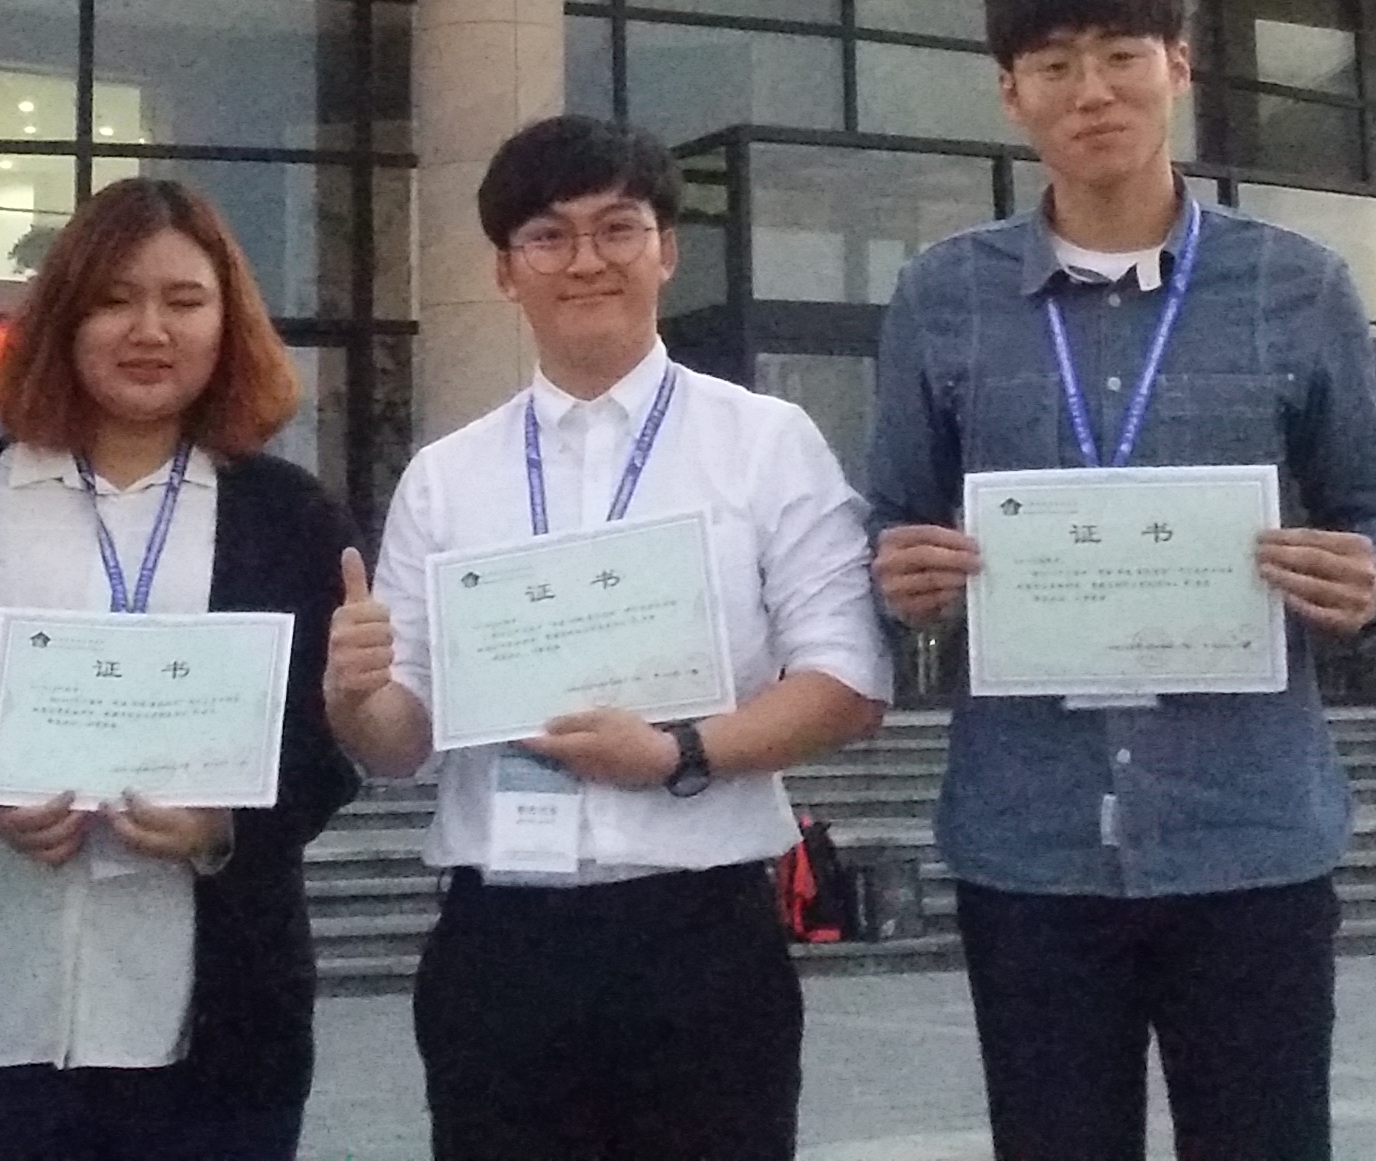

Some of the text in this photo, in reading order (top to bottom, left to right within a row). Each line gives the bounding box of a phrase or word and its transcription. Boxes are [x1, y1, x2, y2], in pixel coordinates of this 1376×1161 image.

[1070, 523, 1173, 543] 证书
[525, 570, 621, 602] 证书
[92, 659, 191, 679] 证书
